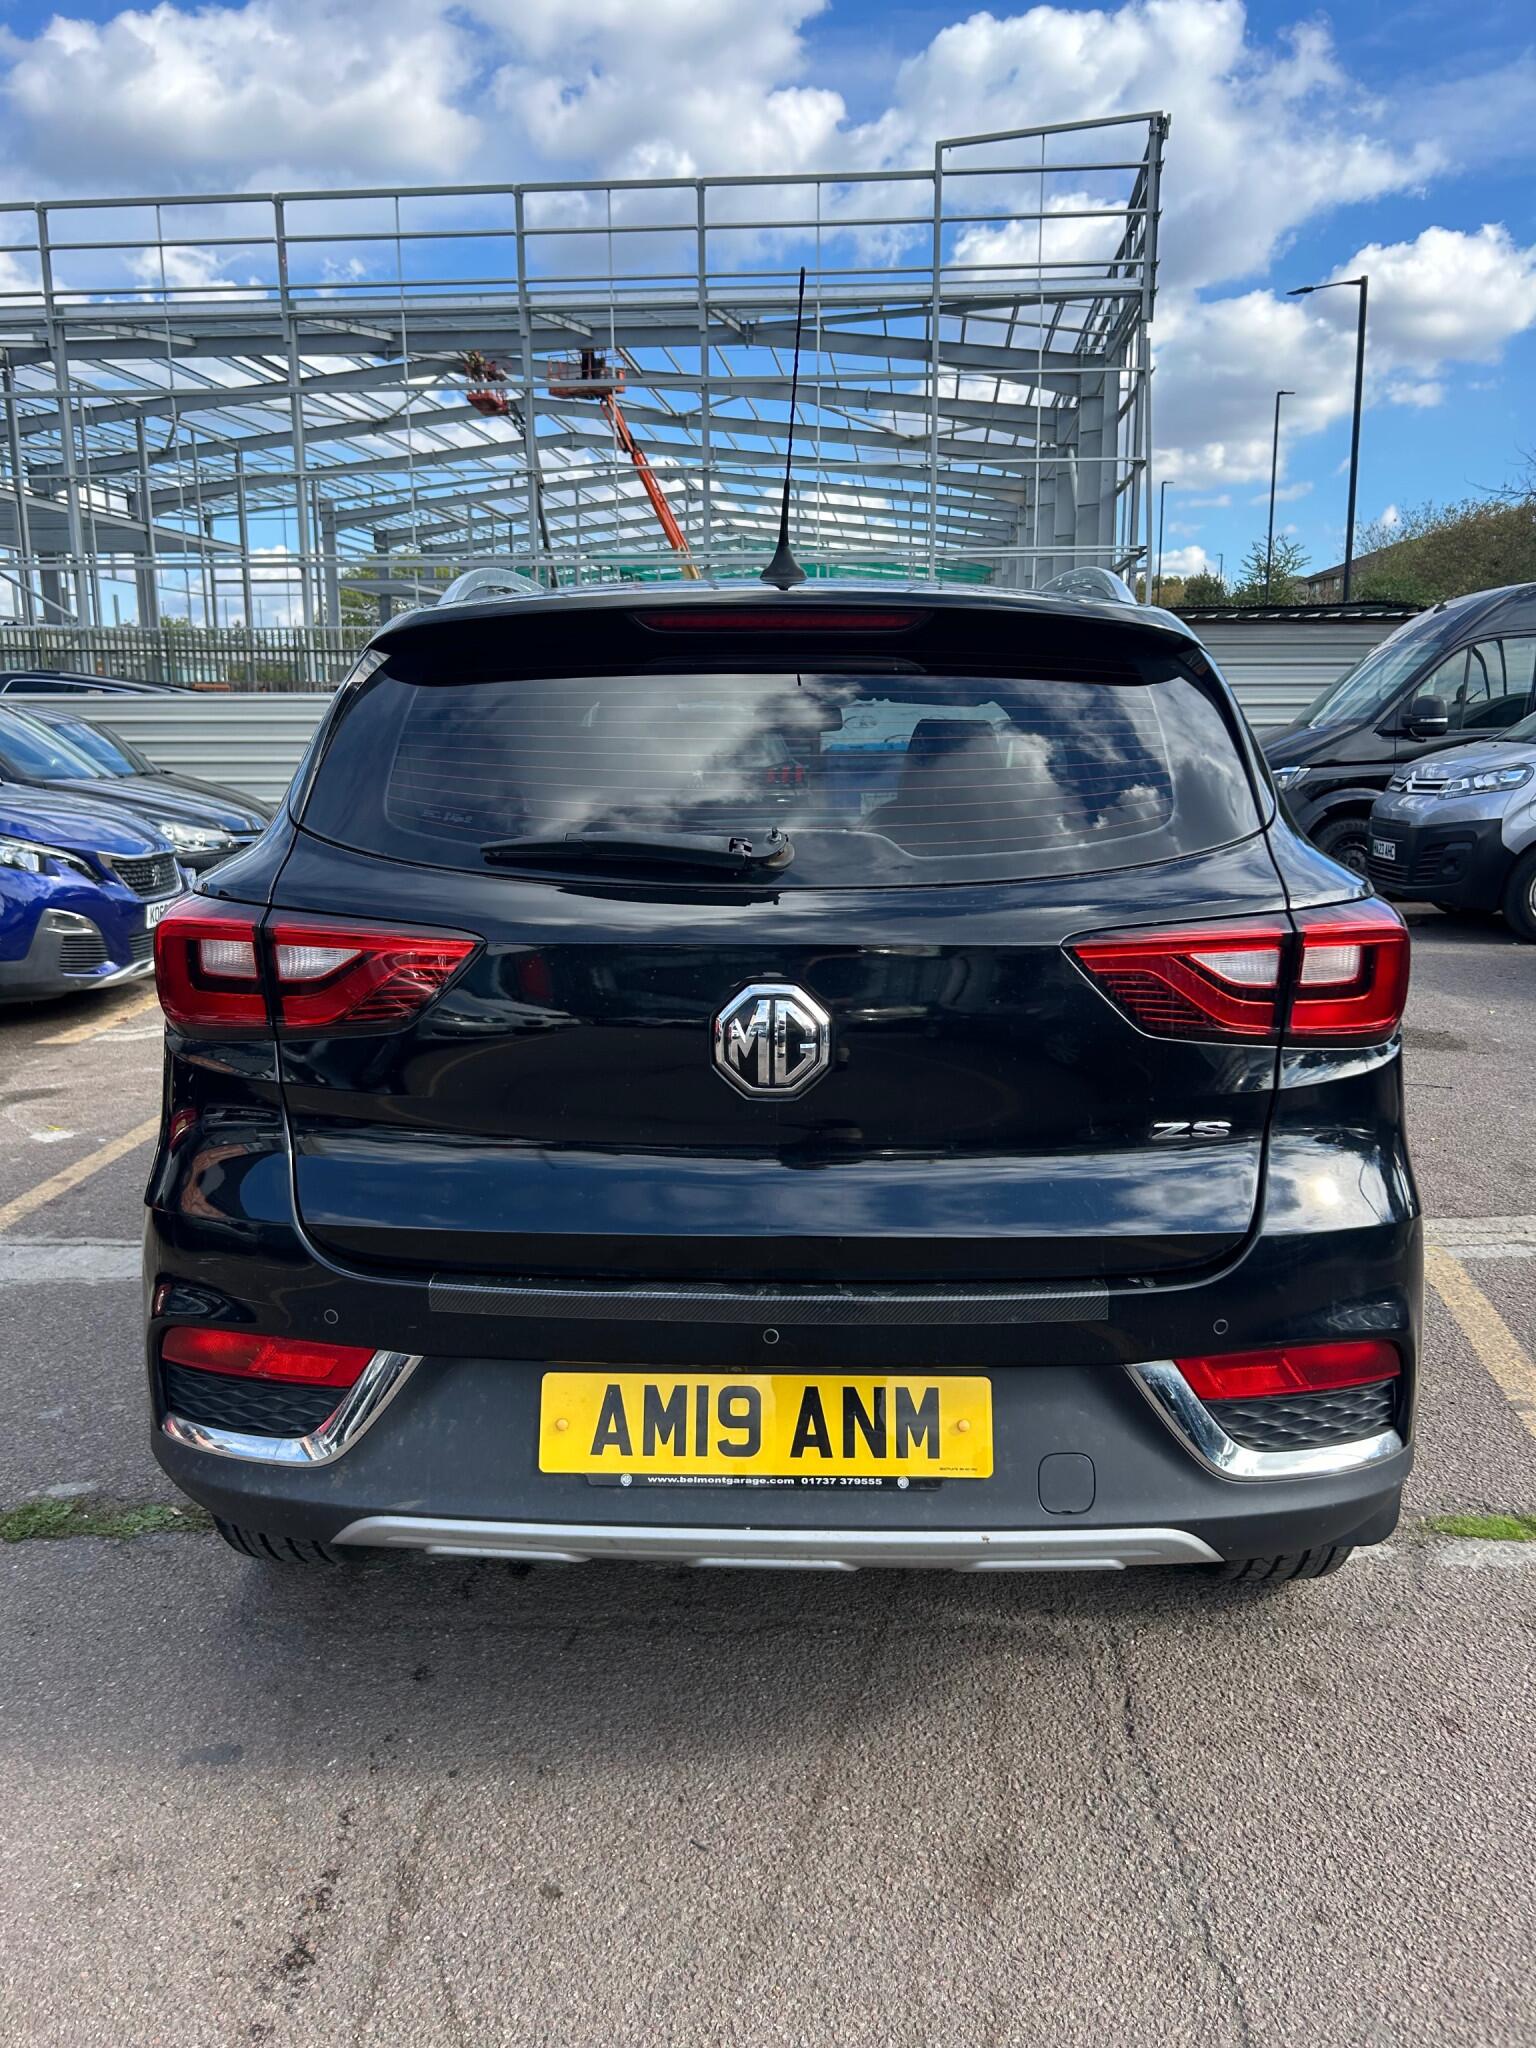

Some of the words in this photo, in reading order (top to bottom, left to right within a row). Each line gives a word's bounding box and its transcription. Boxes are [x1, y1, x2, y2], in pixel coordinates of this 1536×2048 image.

[728, 999, 817, 1085] MG
[1151, 1121, 1232, 1140] ZS
[790, 1386, 940, 1459] ANM
[647, 1476, 795, 1485] www.belmontgarage.com
